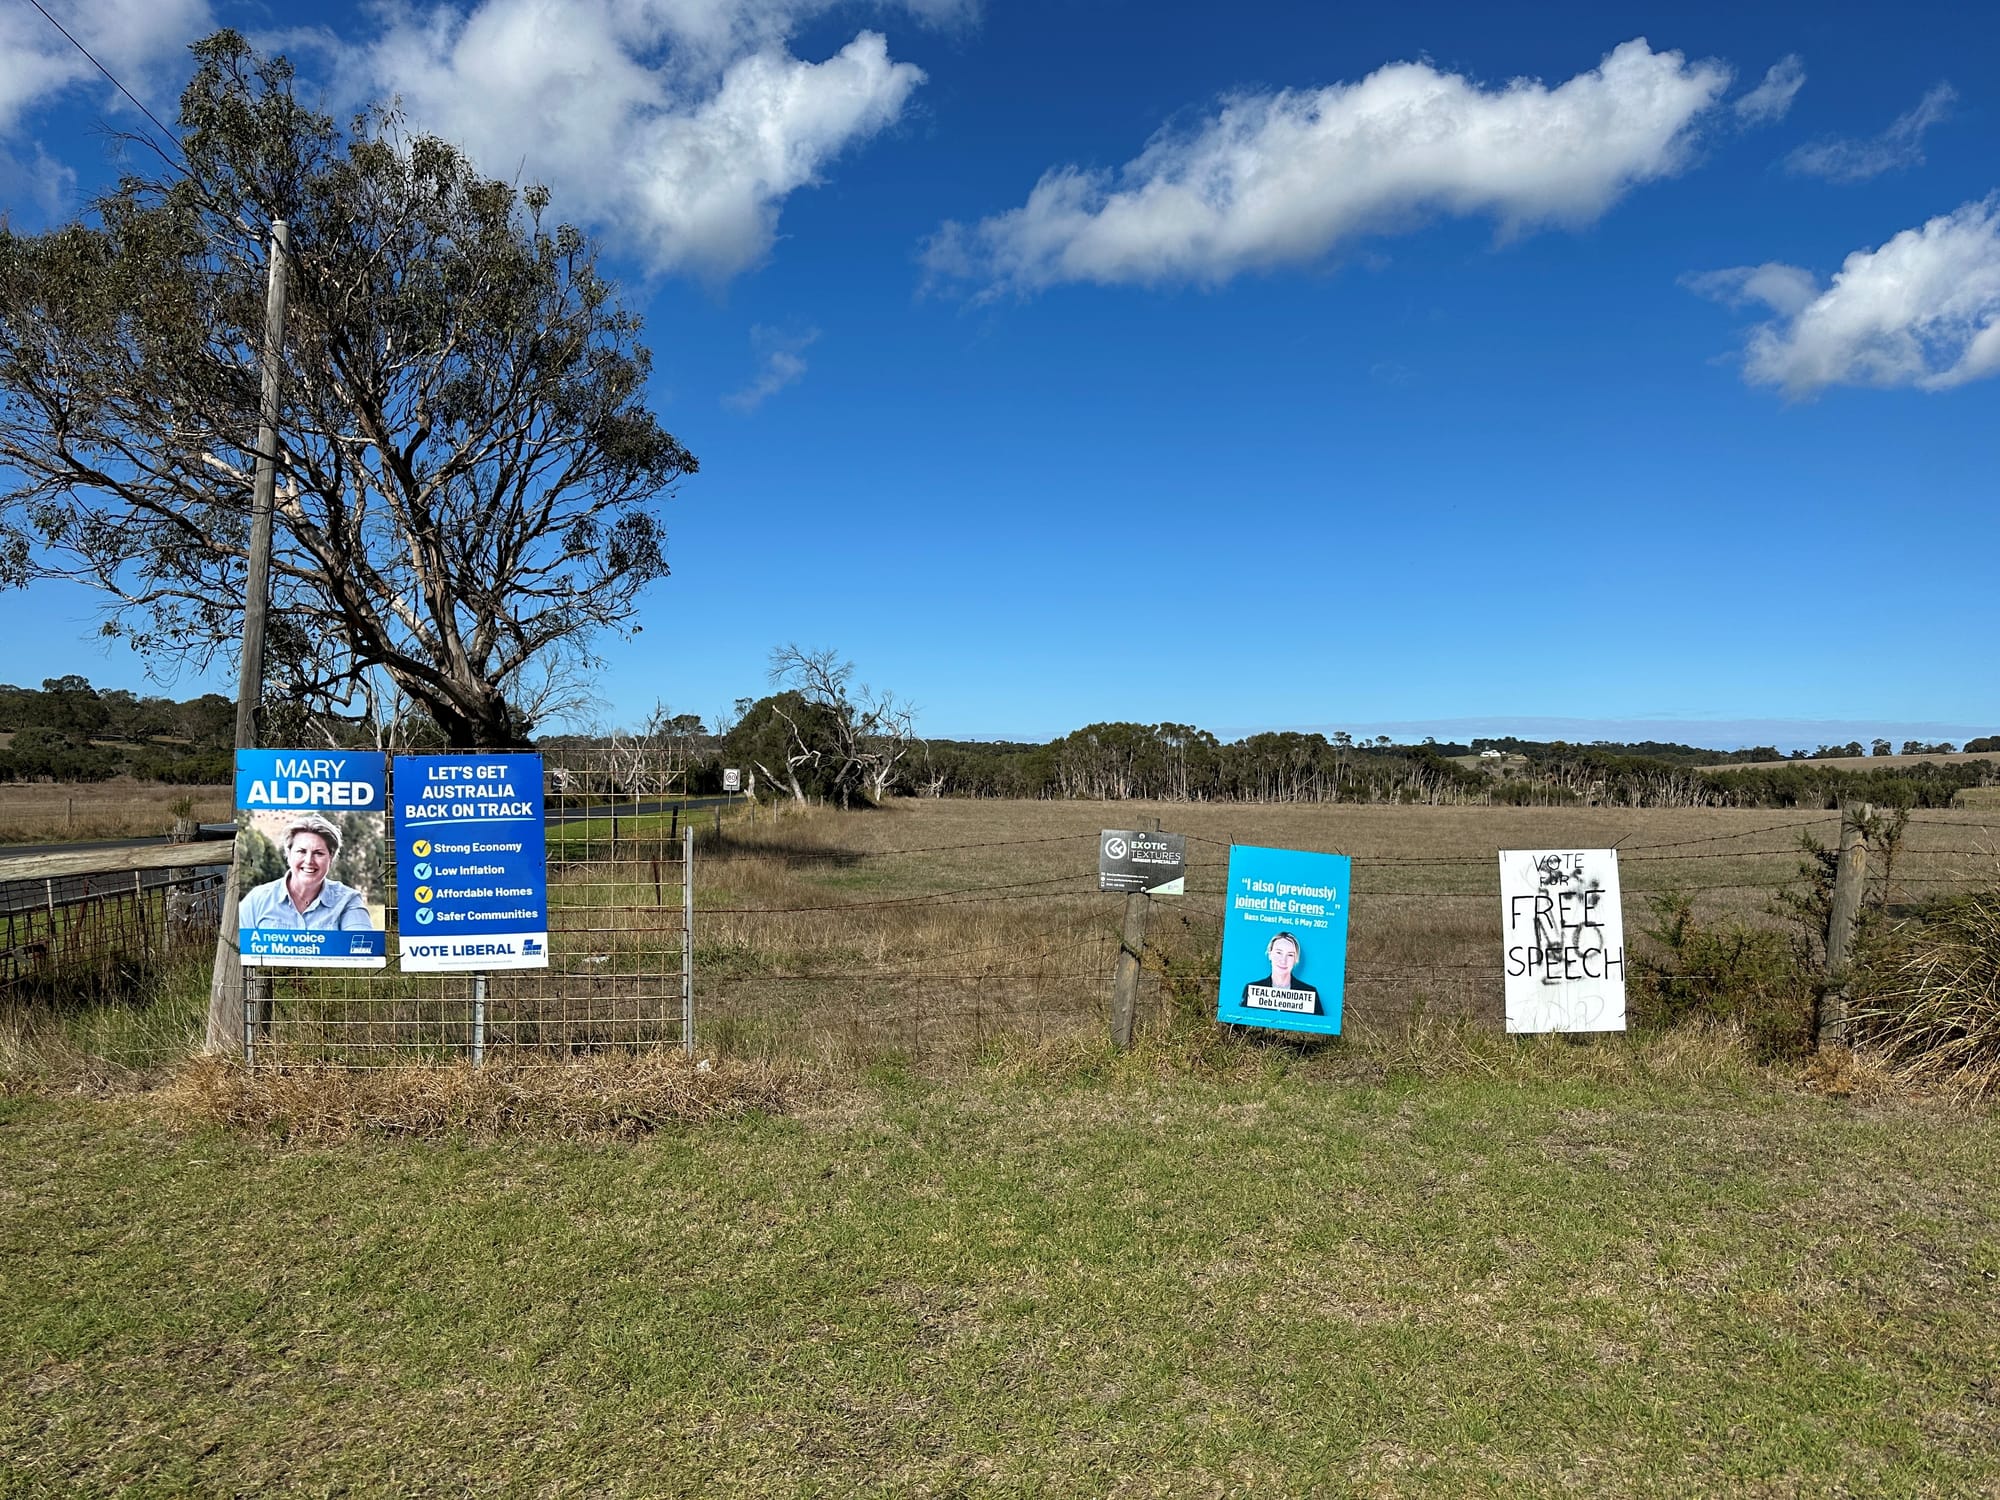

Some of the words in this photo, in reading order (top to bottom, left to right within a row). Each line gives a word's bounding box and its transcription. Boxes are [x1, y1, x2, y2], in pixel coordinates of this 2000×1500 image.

[275, 759, 346, 779] MARY
[428, 765, 472, 781] LET’S
[476, 765, 508, 779] GET
[247, 780, 374, 807] ALDRED
[422, 783, 515, 799] AUSTRALIA
[405, 803, 448, 818] BACK
[451, 802, 474, 817] ON
[477, 801, 533, 816] TRACK
[434, 843, 470, 855] Strong
[472, 841, 522, 854] Economy
[1130, 841, 1167, 850] EXOTIC
[1130, 849, 1181, 861] TEXTURES
[1533, 853, 1585, 872] VOTE
[435, 865, 457, 876] Low
[459, 864, 505, 876] Inflation
[1539, 875, 1569, 887] FOR
[436, 887, 492, 899] Affordable
[495, 886, 533, 897] Homes
[1253, 881, 1274, 893] also
[1276, 881, 1336, 901] (previously)
[1235, 894, 1267, 909] joined
[1269, 897, 1287, 910] the
[1288, 899, 1324, 914] Greens
[1511, 889, 1606, 930] FREE
[437, 910, 465, 922] Safer
[467, 908, 538, 921] Communities
[1244, 913, 1259, 922] Bass
[1259, 914, 1277, 923] Coast
[1277, 916, 1293, 925] Post,
[1294, 918, 1299, 926] 6
[1299, 918, 1313, 928] May
[1313, 919, 1329, 928] 2022
[250, 931, 261, 942] A
[263, 934, 289, 943] new
[291, 932, 325, 943] voice
[250, 943, 269, 954] for
[271, 943, 320, 955] Monash
[409, 945, 449, 957] VOTE
[453, 943, 516, 956] LIBERAL
[1507, 946, 1624, 982] SPEECH
[1250, 987, 1269, 998] TEAL
[1270, 989, 1313, 1002] CANDIDATE
[1258, 997, 1273, 1006] Deb
[1274, 999, 1304, 1010] Leonard
